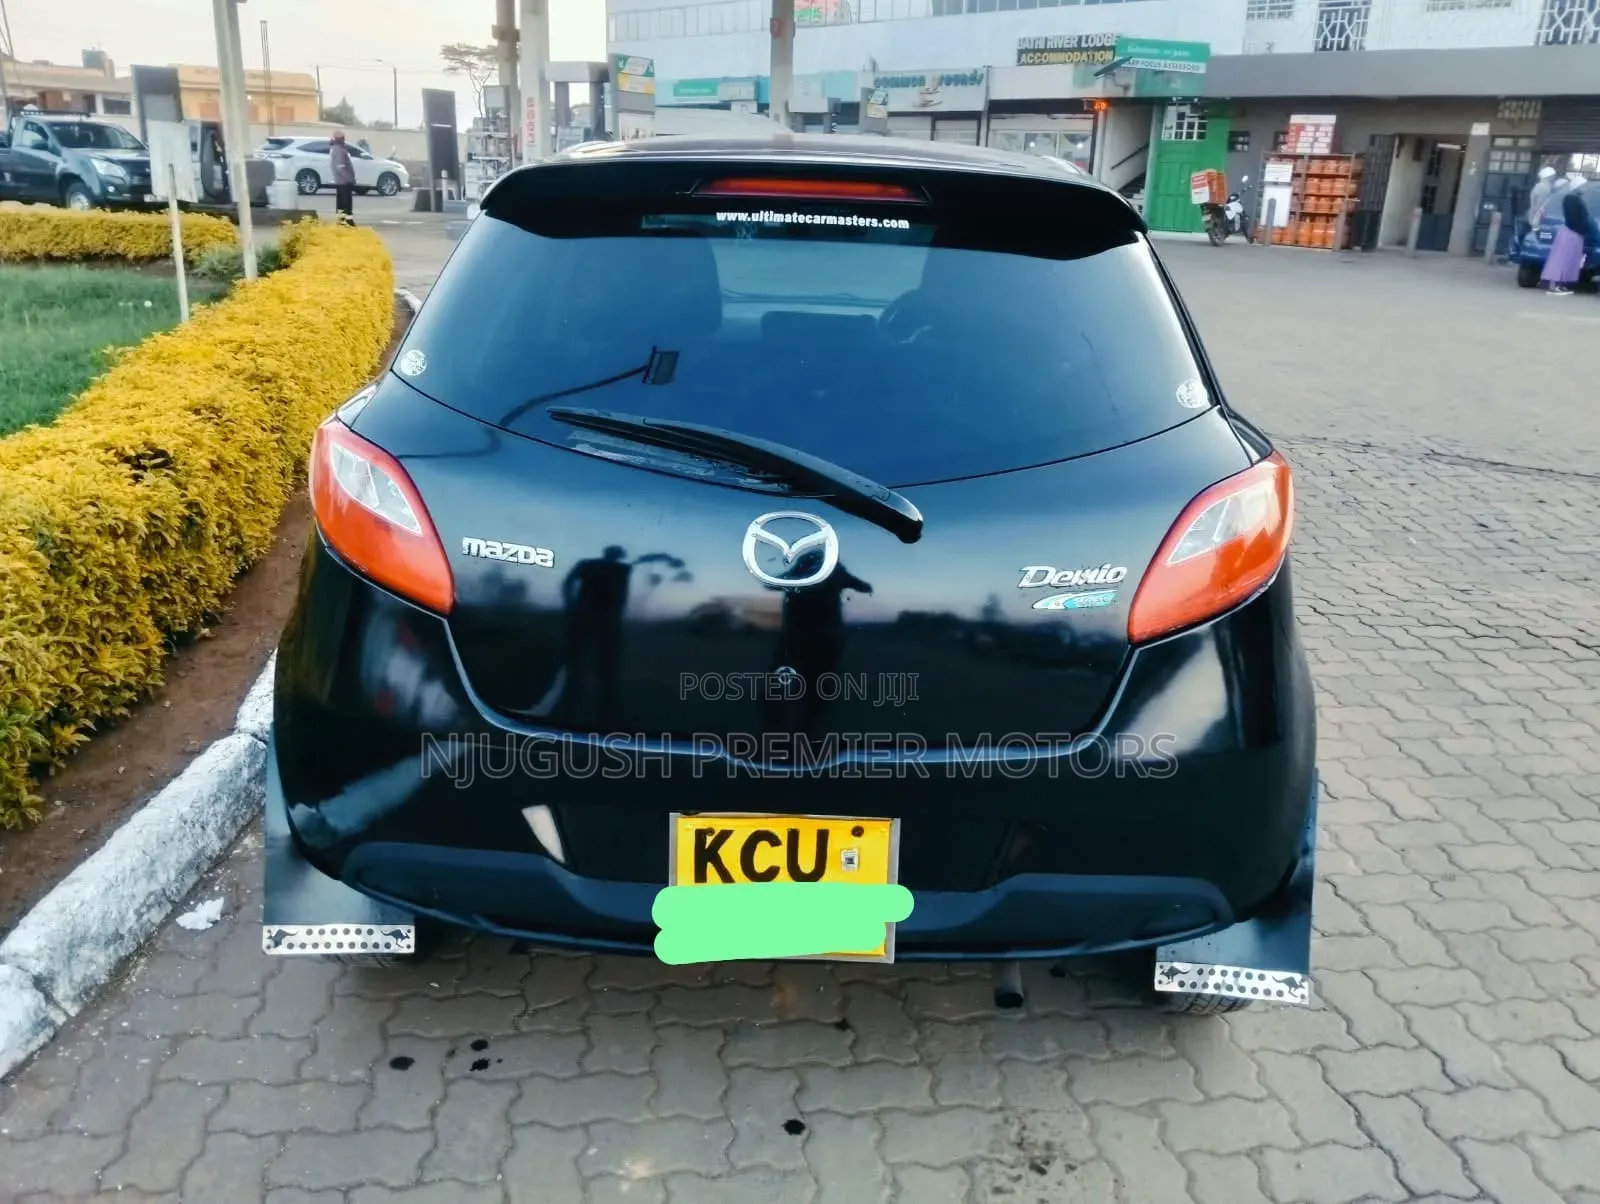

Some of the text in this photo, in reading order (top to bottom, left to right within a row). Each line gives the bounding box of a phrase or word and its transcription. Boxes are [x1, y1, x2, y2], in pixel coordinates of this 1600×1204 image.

[1047, 34, 1078, 49] RIVER
[1080, 31, 1119, 48] LODGE
[1020, 49, 1114, 65] ACCOMMODATION
[716, 210, 909, 229] www.ultimatecarmasters.com
[694, 828, 830, 884] KCU
